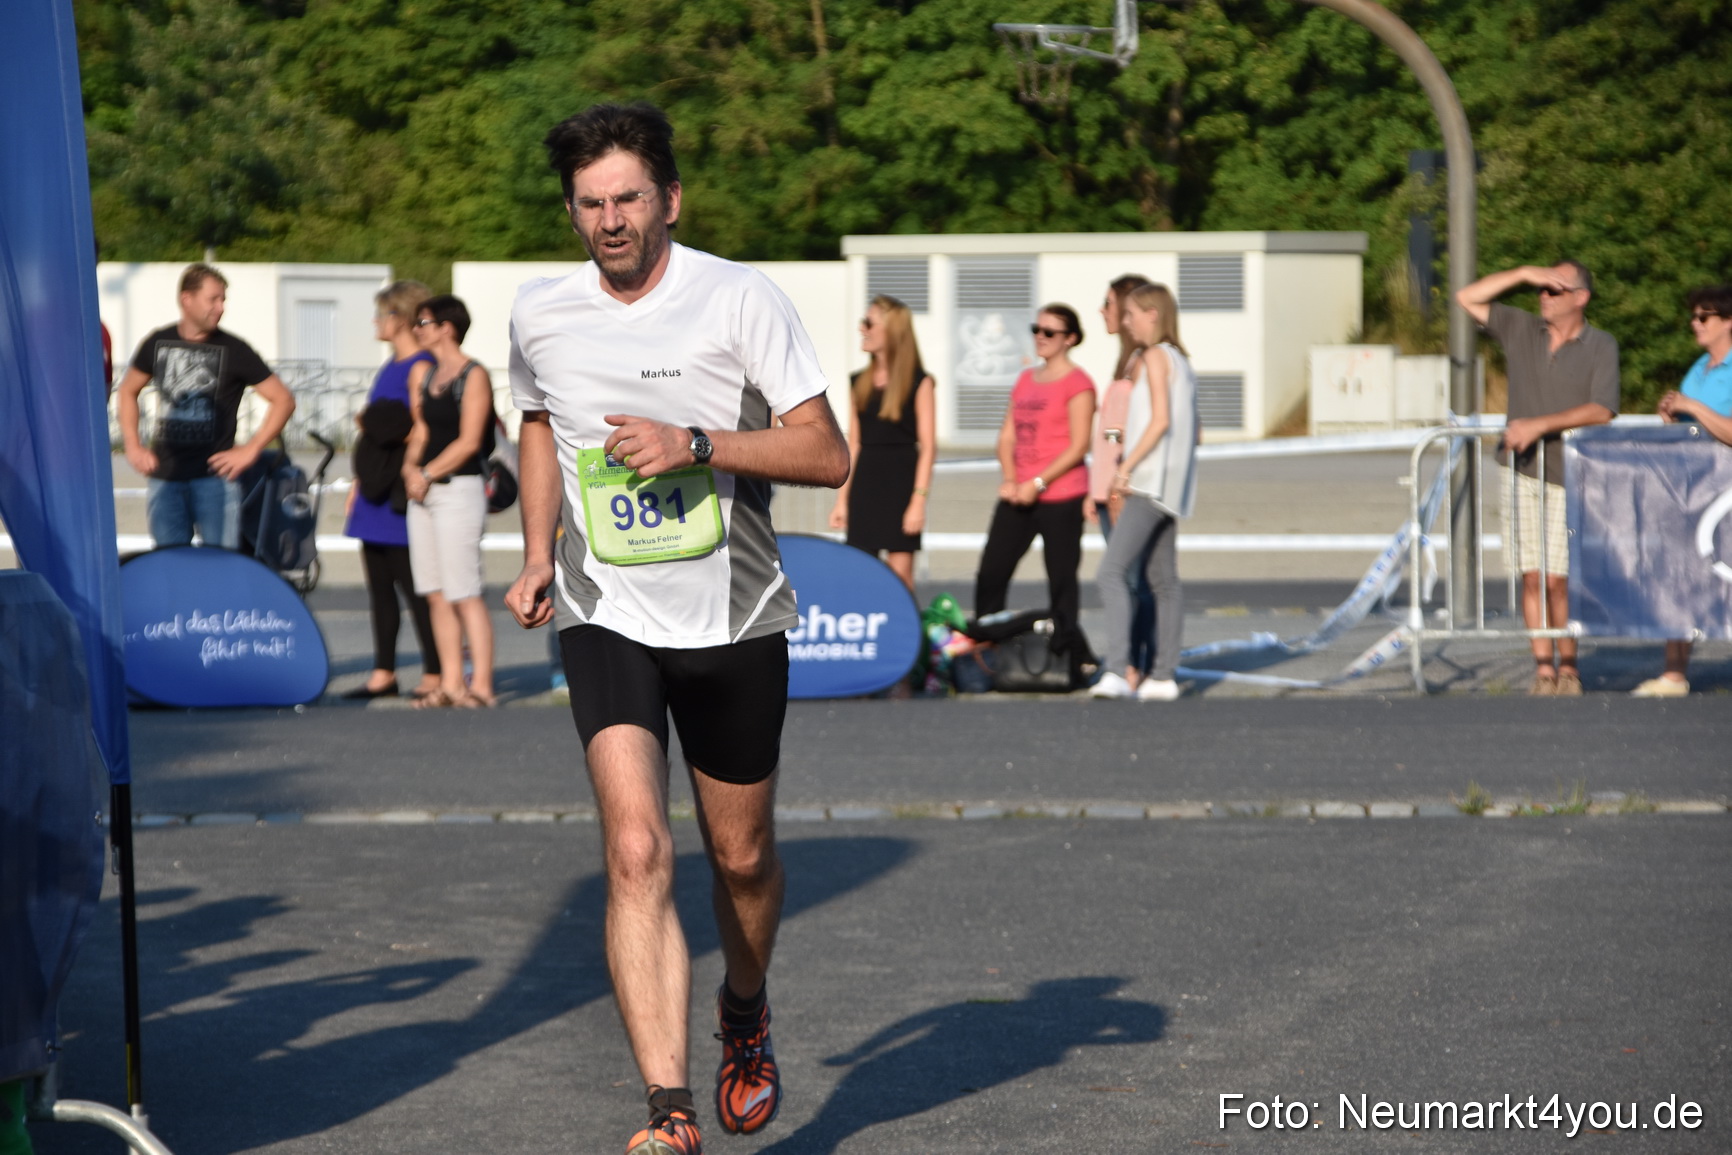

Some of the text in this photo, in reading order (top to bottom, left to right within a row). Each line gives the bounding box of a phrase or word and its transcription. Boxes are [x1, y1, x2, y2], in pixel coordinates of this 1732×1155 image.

[641, 368, 681, 379] Markus
[610, 487, 686, 531] 981
[627, 538, 657, 546] Markus
[143, 612, 184, 641] und
[185, 608, 223, 635] das
[199, 635, 296, 669] fährt mit!
